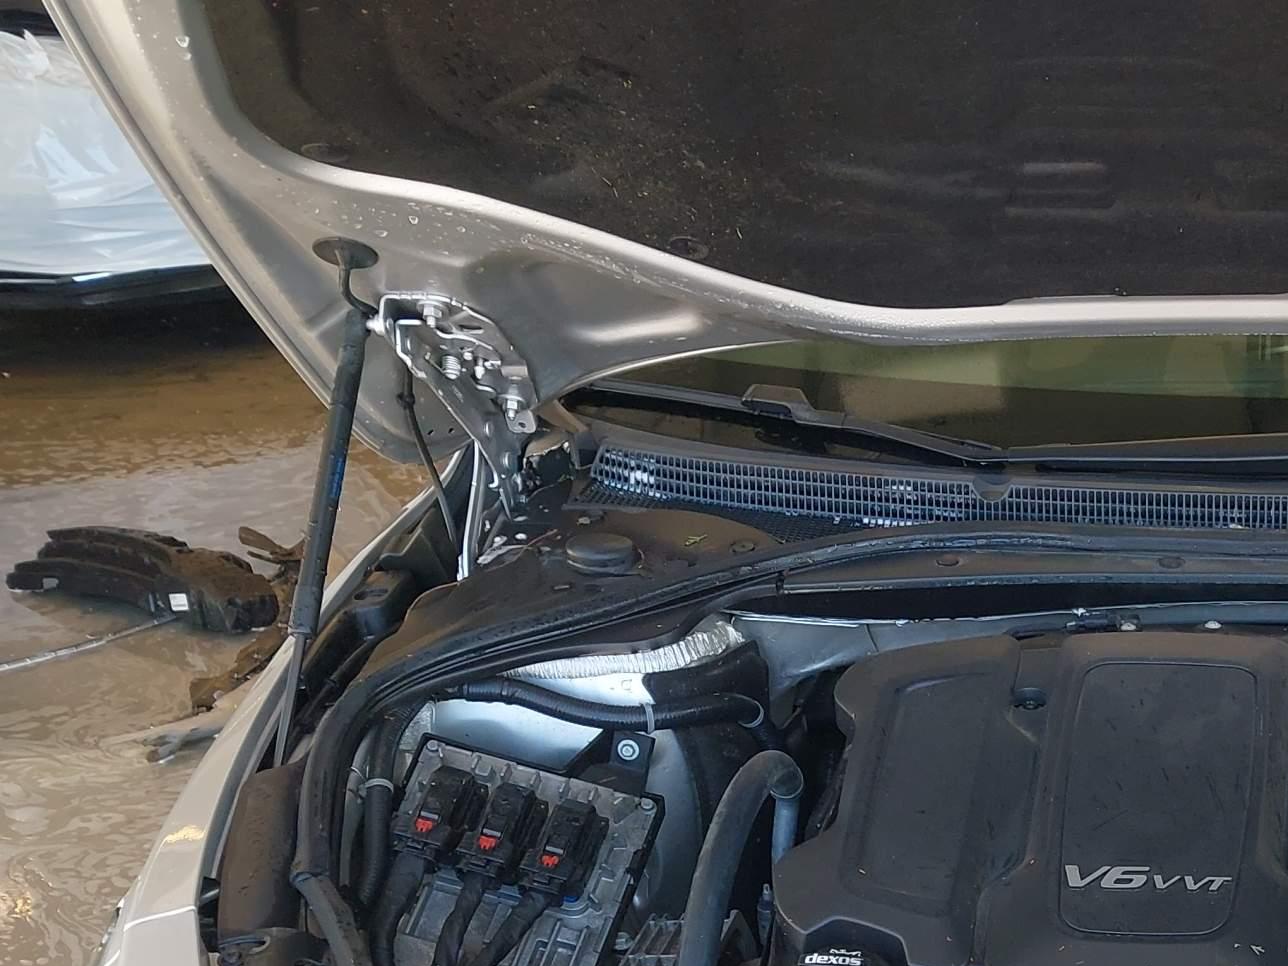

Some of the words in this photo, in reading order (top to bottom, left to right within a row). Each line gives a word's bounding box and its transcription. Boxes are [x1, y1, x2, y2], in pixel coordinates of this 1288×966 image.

[1064, 864, 1151, 889] V6
[1153, 874, 1233, 891] VVT
[804, 953, 863, 966] dexos
